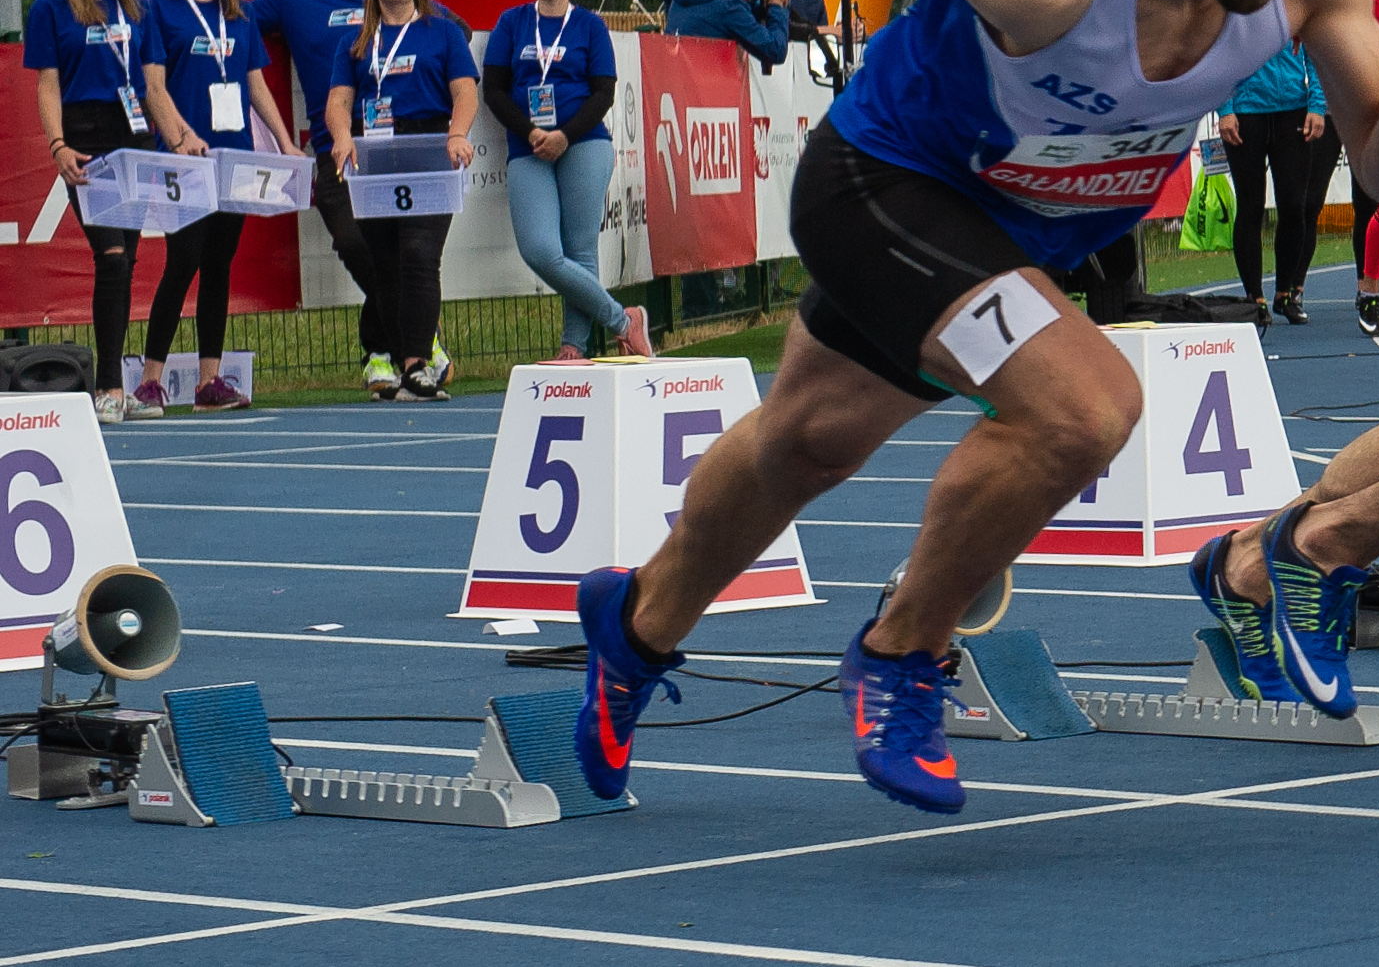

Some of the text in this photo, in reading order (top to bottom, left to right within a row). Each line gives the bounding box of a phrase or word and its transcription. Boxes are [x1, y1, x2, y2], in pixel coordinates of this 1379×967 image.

[1030, 73, 1119, 115] AZS
[690, 120, 738, 182] ORLEN
[1102, 128, 1186, 160] 347
[164, 171, 181, 202] 5
[256, 169, 271, 199] 7
[394, 185, 413, 211] 8
[971, 292, 1016, 345] 7
[1184, 338, 1236, 361] polanik
[543, 381, 593, 402] polanik
[663, 374, 725, 399] polanik
[1183, 370, 1252, 497] 4
[519, 415, 585, 554] 5
[0, 449, 76, 596] 6
